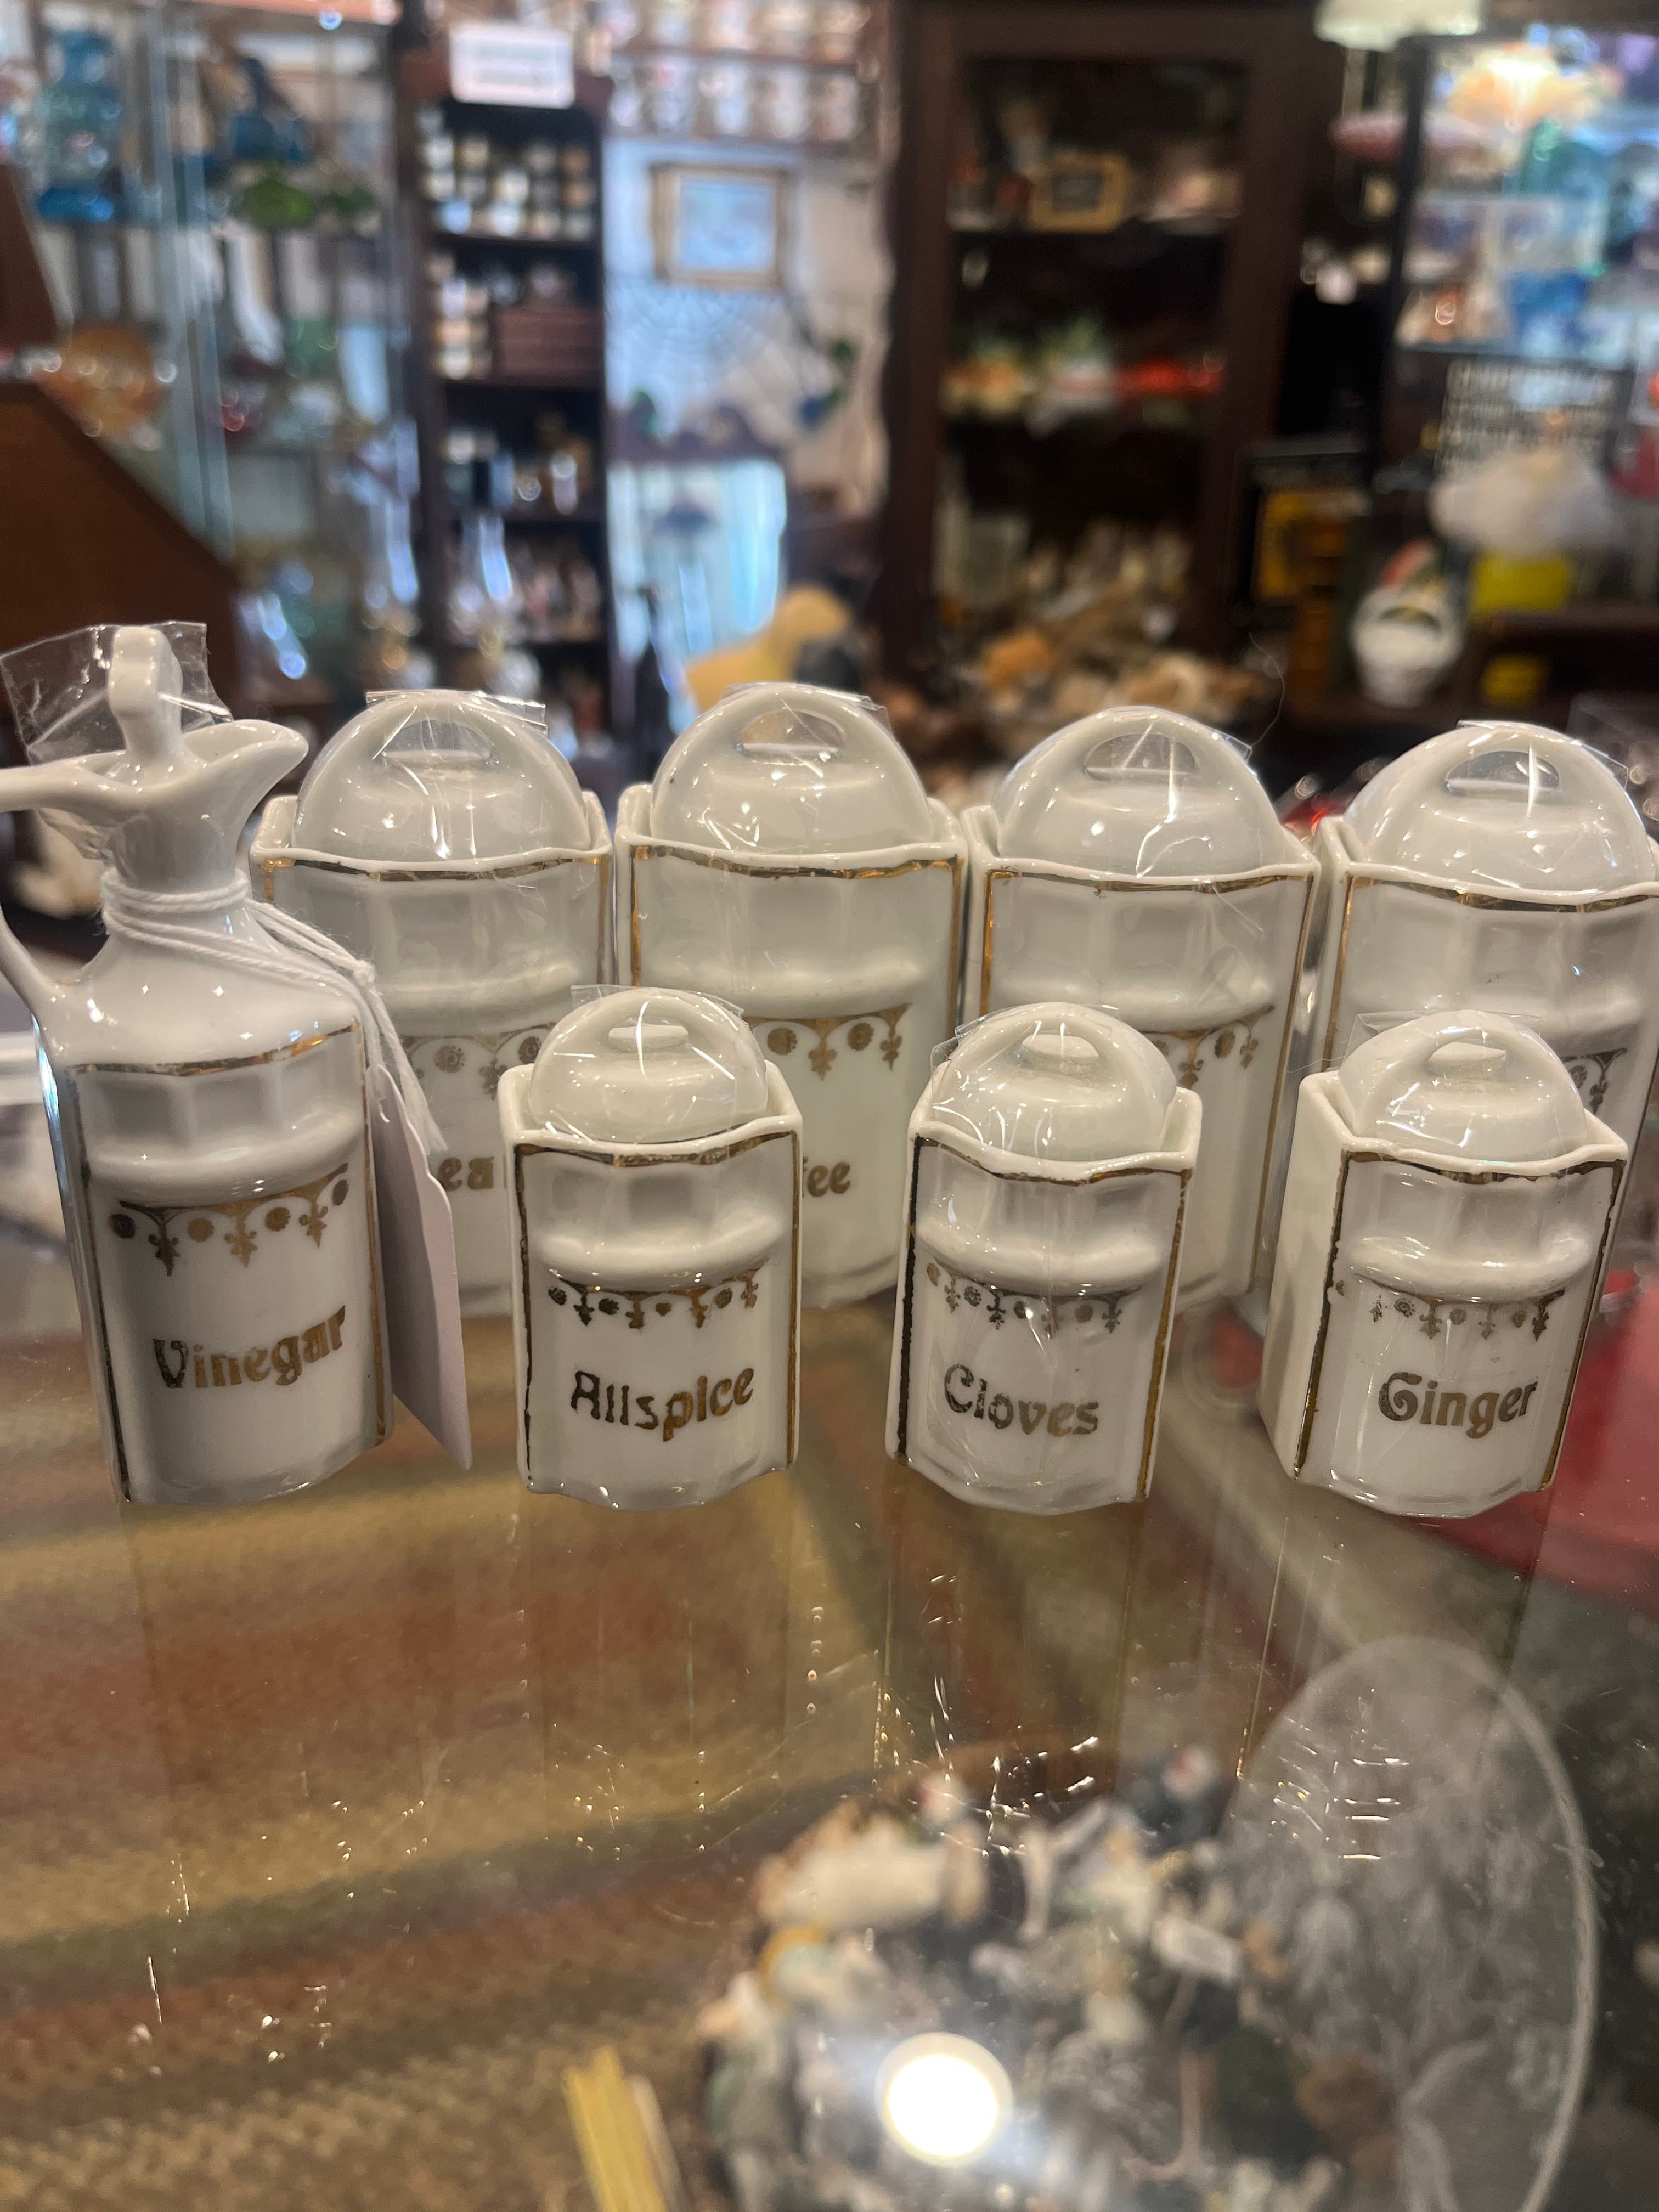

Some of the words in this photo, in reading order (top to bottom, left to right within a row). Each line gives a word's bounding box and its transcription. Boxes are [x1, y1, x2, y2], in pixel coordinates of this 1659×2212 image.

[437, 1156, 494, 1191] ea
[153, 1305, 346, 1388] Vinegar
[571, 1368, 754, 1442] Allspice
[944, 1363, 1099, 1437] Cloves
[1379, 1372, 1538, 1439] Ginger
